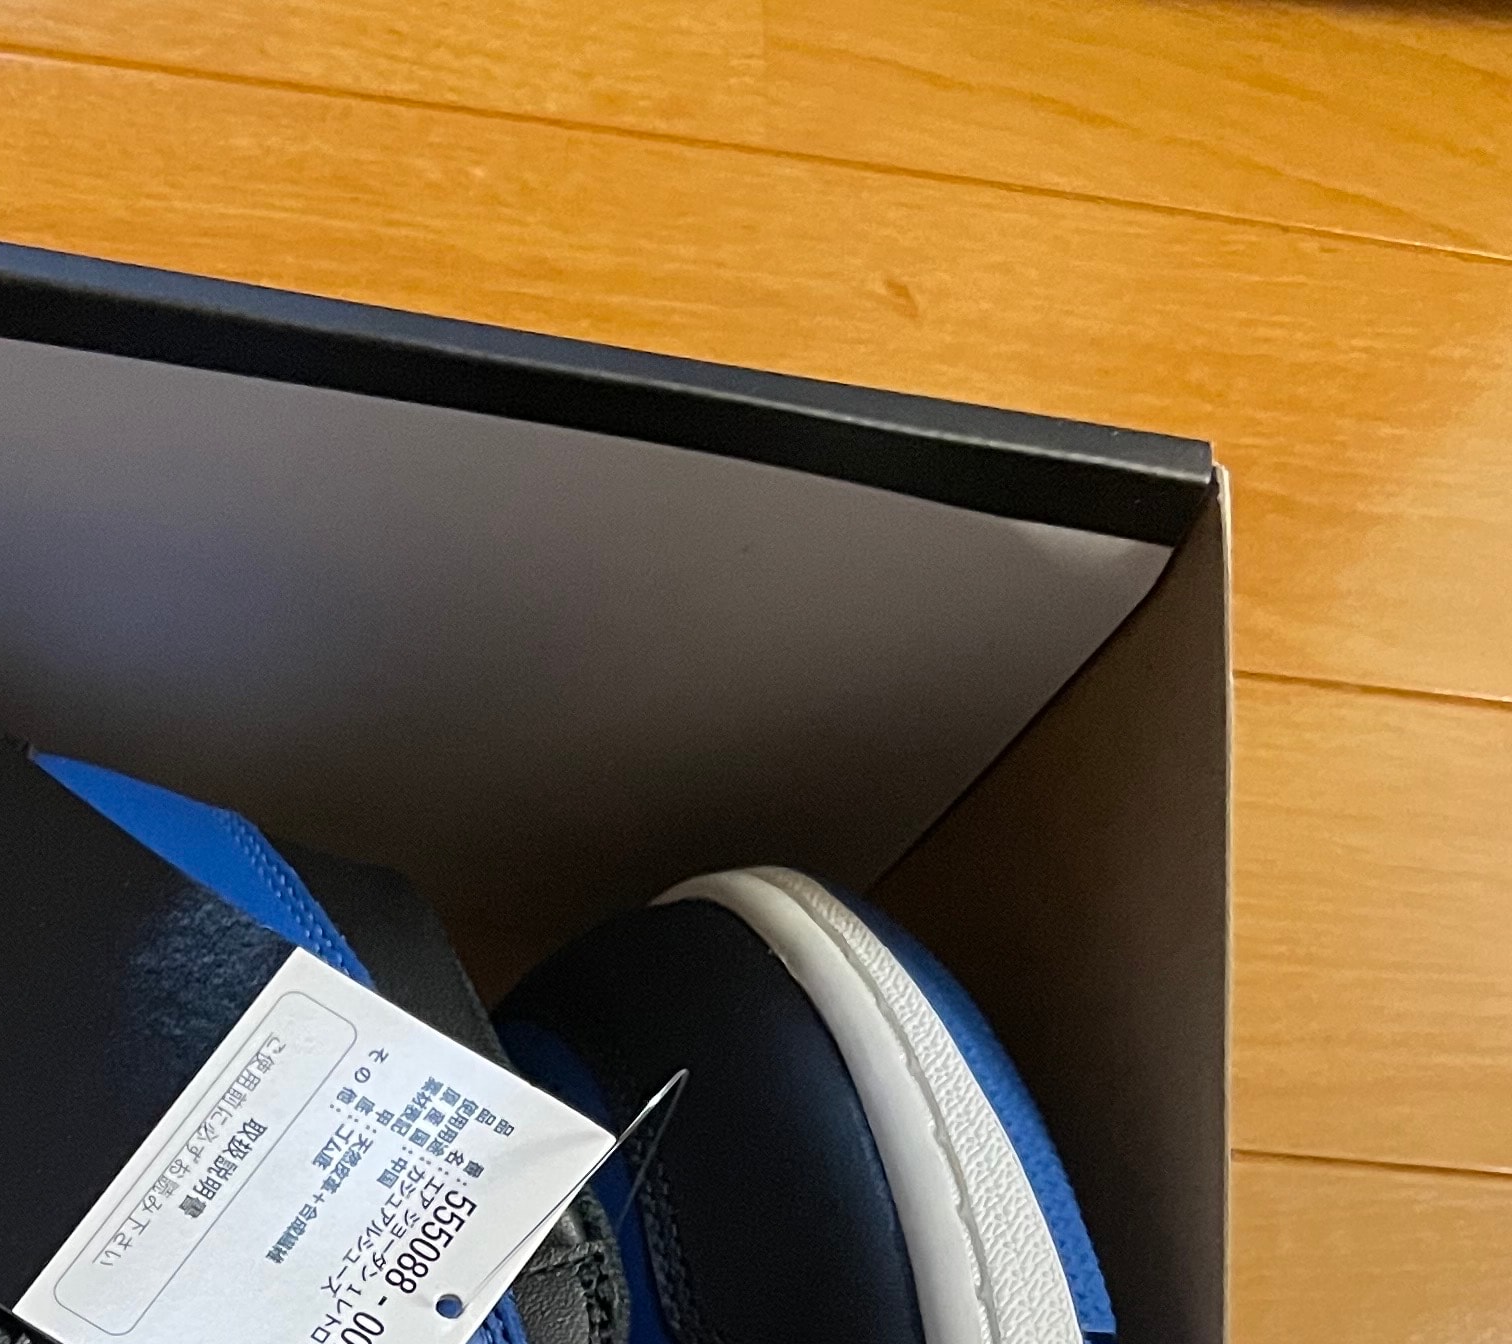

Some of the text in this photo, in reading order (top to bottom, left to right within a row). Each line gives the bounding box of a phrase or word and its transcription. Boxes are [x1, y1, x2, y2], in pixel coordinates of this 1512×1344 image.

[98, 1035, 287, 1266] ご使用前に必ずお読み下さい
[177, 1116, 269, 1219] 取扱説明書
[383, 1188, 478, 1295] 555088
